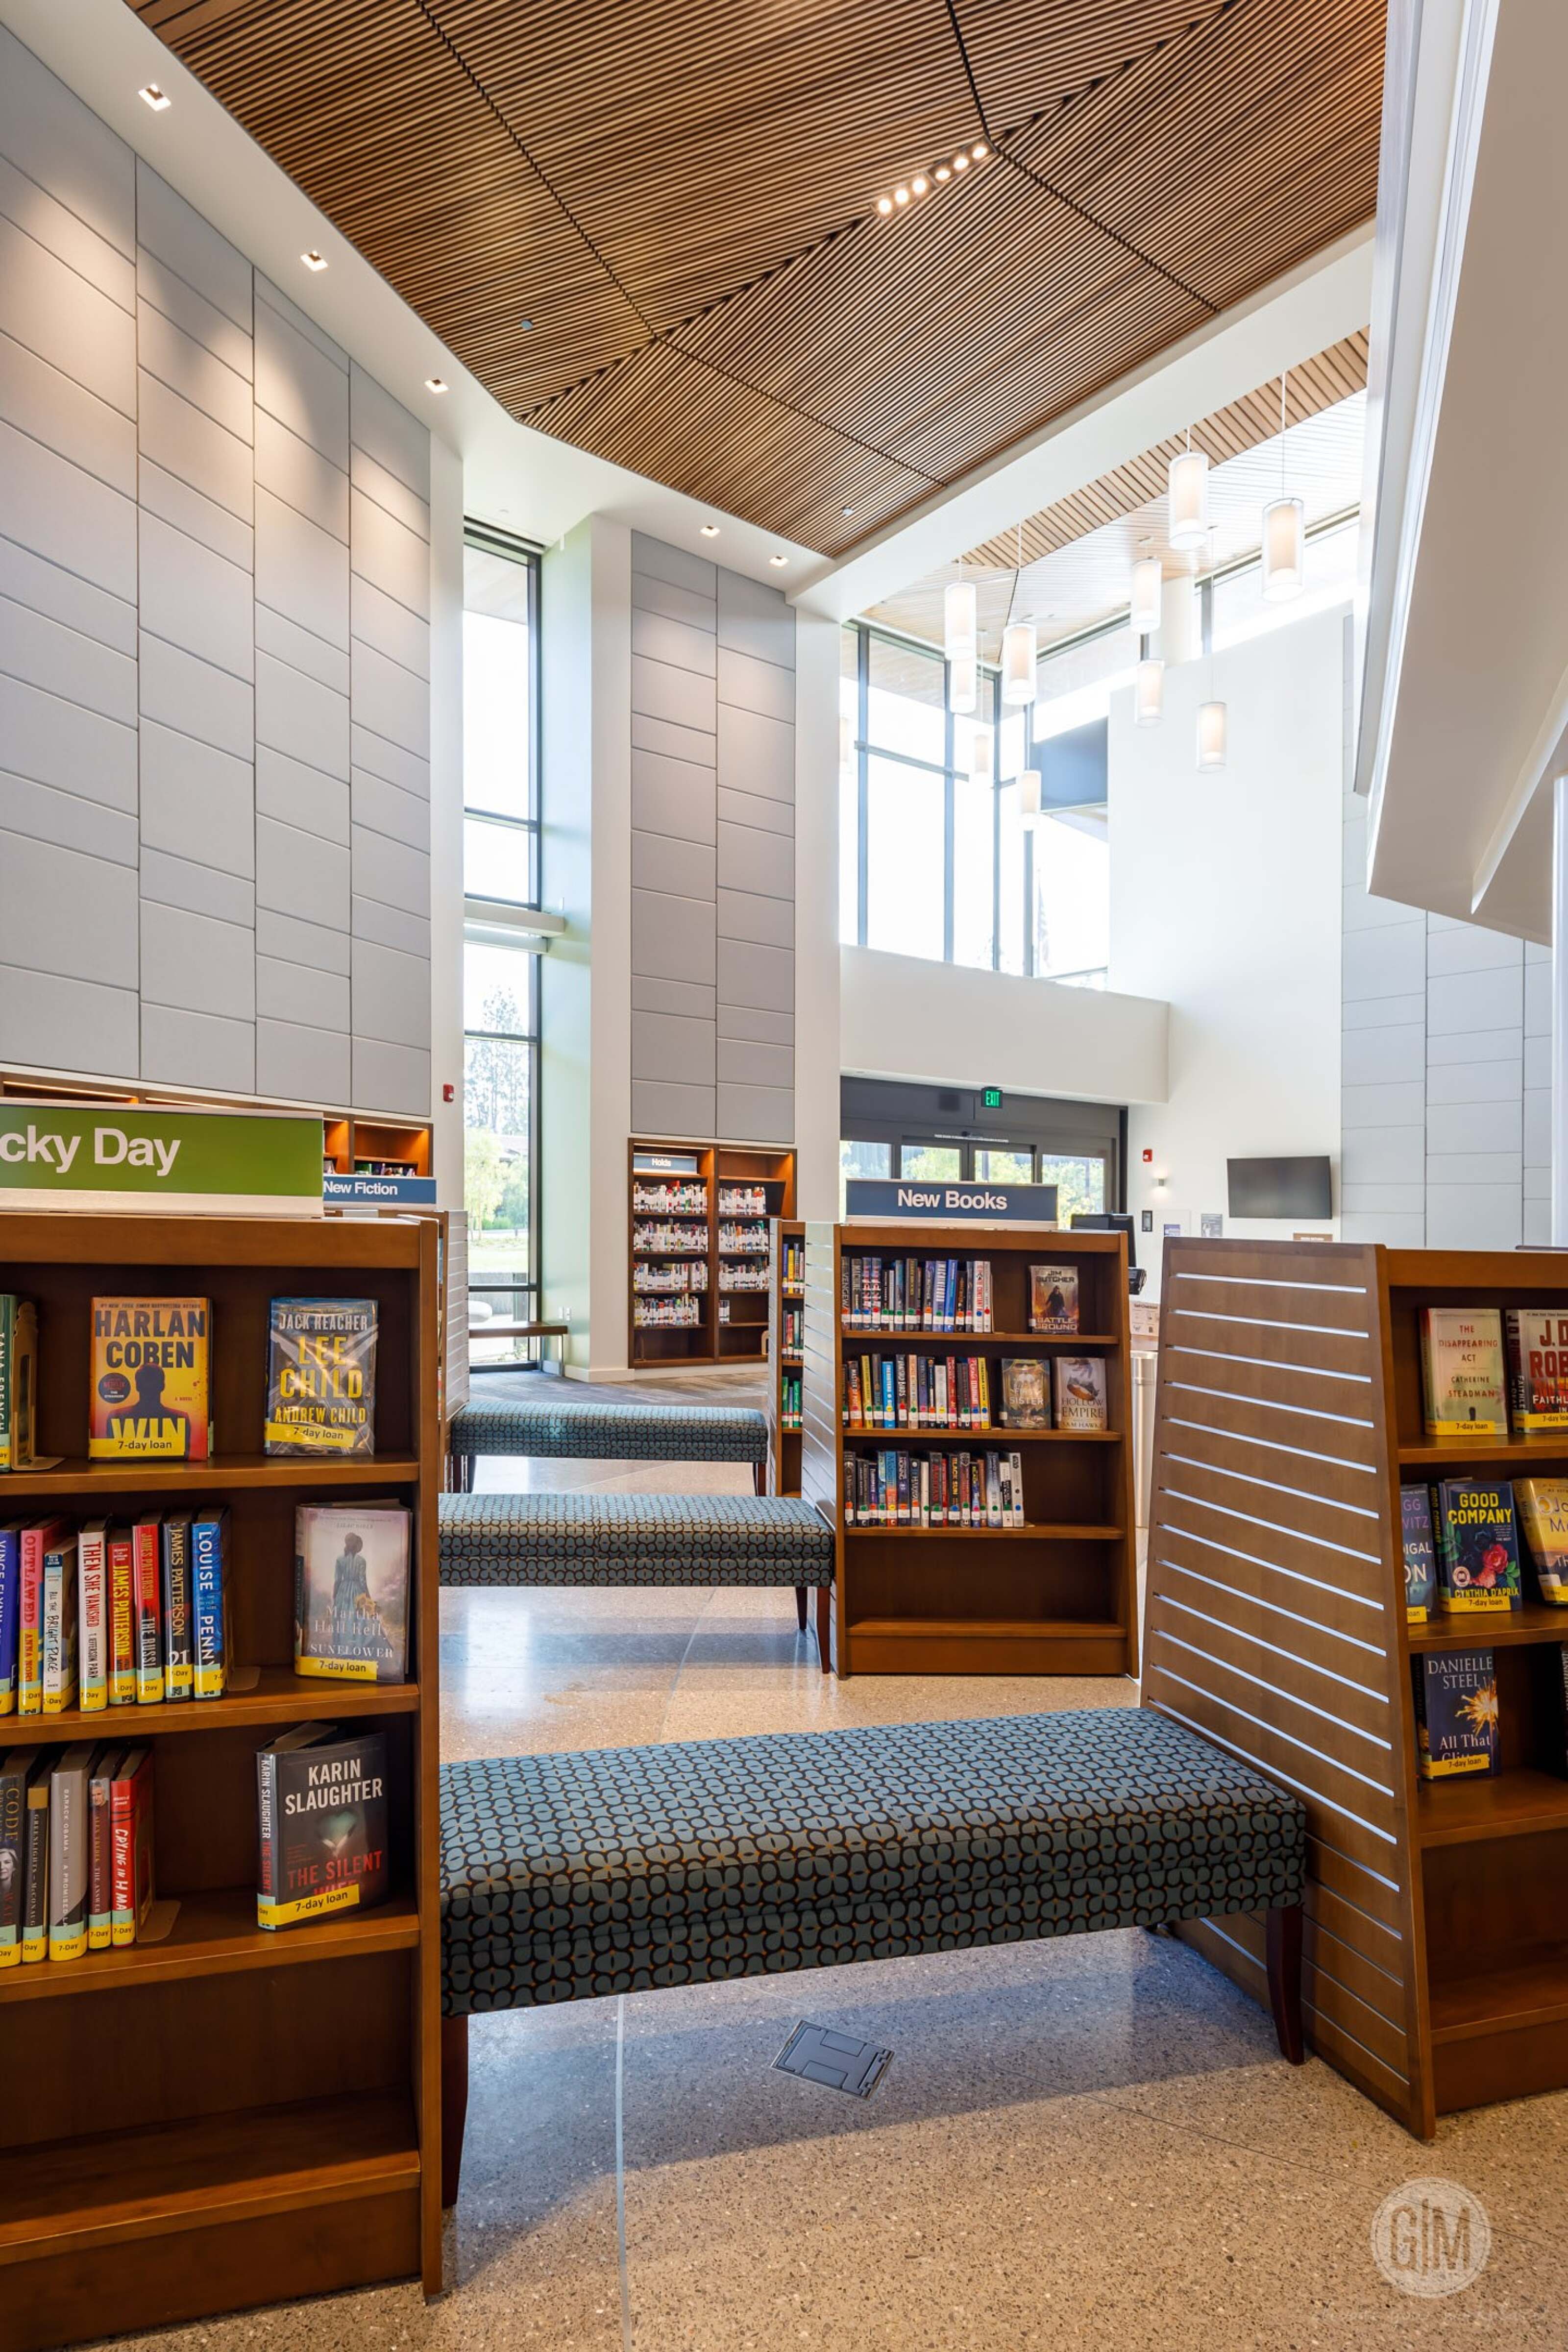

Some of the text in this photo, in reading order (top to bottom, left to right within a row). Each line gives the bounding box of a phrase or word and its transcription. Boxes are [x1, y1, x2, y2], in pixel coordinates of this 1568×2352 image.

[986, 1091, 1000, 1106] EXIT
[0, 1125, 181, 1176] cky Day
[652, 1158, 671, 1167] Holds
[323, 1181, 398, 1195] New Fiction
[898, 1189, 1007, 1210] New Books
[95, 1310, 205, 1337] HARLAN
[279, 1313, 368, 1331] JACK REACHER
[106, 1341, 195, 1368] COBEN
[298, 1335, 347, 1365] LEE
[279, 1368, 363, 1398] CHILD
[1062, 1397, 1104, 1406] HOLLOW
[1062, 1406, 1104, 1418] EMPIRE
[275, 1406, 366, 1423] ANDREW CHILD
[111, 1418, 186, 1439] WIN
[294, 1426, 343, 1440] 7-day loan
[118, 1440, 172, 1451] 7-day loan
[1459, 1493, 1499, 1508] GOOD
[1448, 1509, 1512, 1525] COMPANY
[141, 1533, 153, 1599] JAMES PATTERSON
[198, 1531, 212, 1591] LOUISE
[24, 1535, 36, 1623] OUTLAWED
[82, 1541, 101, 1628] THEN SHE VANISHED
[113, 1566, 129, 1596] JAMES
[170, 1529, 184, 1636] JAMES PATTERSON
[326, 1605, 380, 1621] Martha
[46, 1615, 59, 1643] BRIGHT
[113, 1601, 129, 1655] PATTERSON
[141, 1617, 155, 1635] THE
[315, 1620, 388, 1640] Hall Kelly
[24, 1633, 33, 1657] ANNA
[309, 1642, 393, 1659] SUNFLOWER
[318, 1660, 367, 1672] 7-day loan
[1428, 1656, 1493, 1674] DANIELLE
[1443, 1673, 1480, 1690] STEEL
[1439, 1734, 1491, 1750] All That
[261, 1760, 271, 1787] KARIN
[308, 1758, 361, 1787] KARIN
[285, 1778, 383, 1815] SLAUGHTER
[5, 1787, 20, 1842] CODE
[261, 1789, 271, 1838] SLAUGHTER
[115, 1829, 128, 1866] CRYING
[287, 1864, 319, 1889] THE
[326, 1850, 382, 1881] SILENT
[116, 1880, 127, 1891] H
[295, 1891, 348, 1912] 7-day loan
